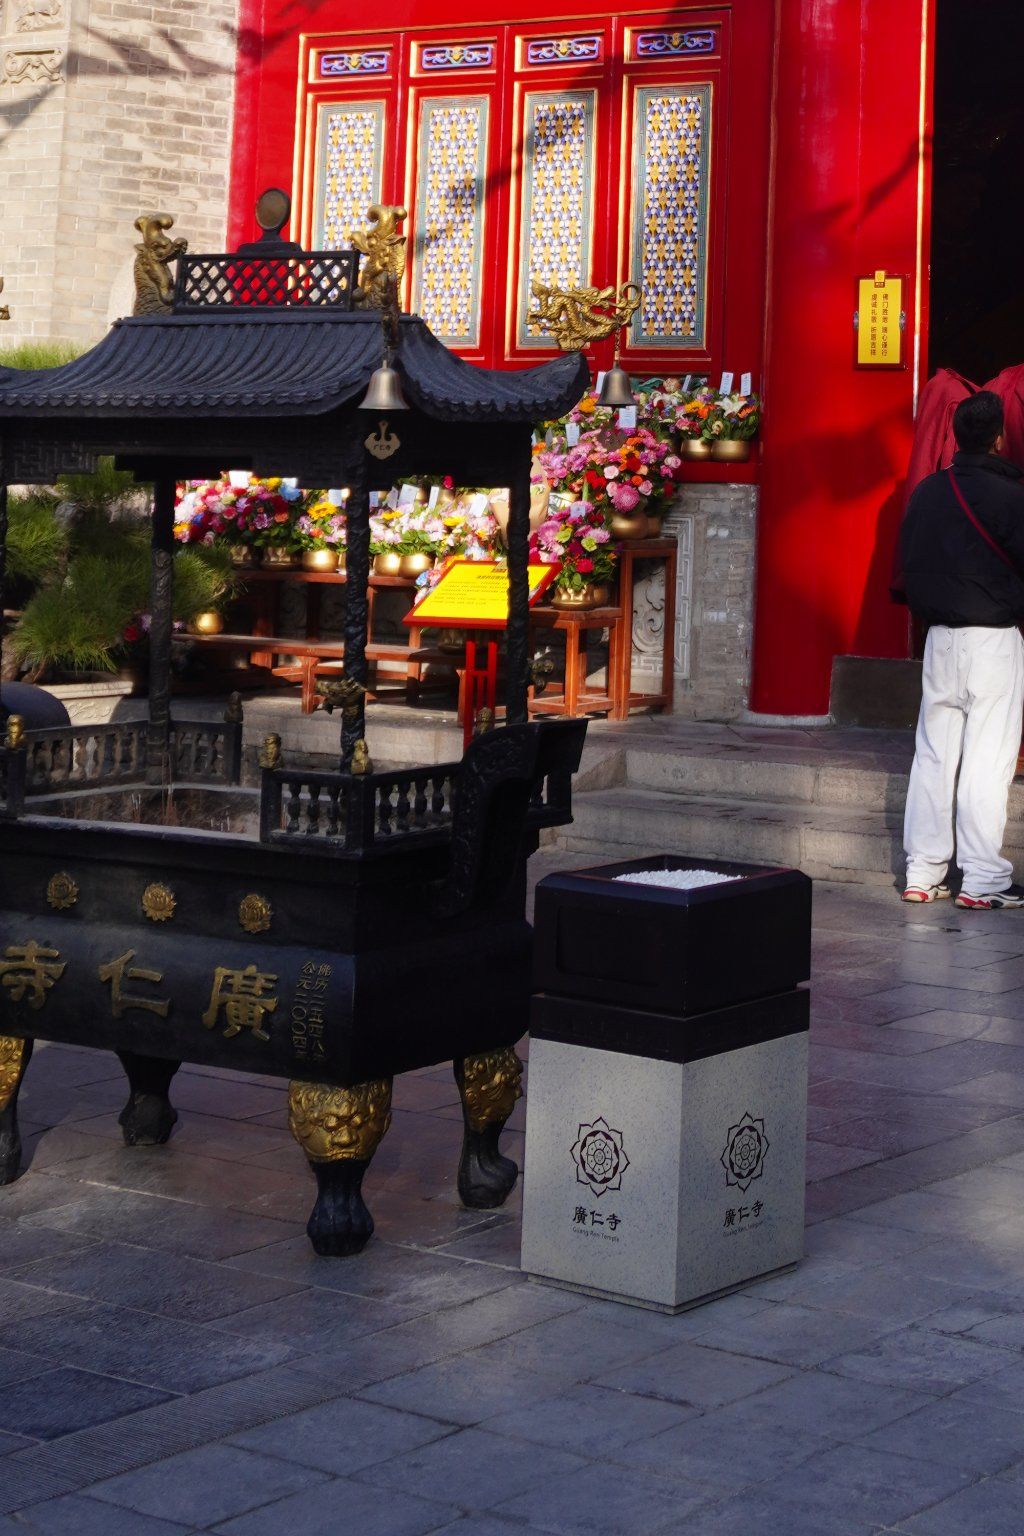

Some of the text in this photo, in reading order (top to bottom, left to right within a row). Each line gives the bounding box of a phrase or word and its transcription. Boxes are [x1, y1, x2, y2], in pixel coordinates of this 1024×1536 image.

[572, 1206, 622, 1231] 廣仁寺
[723, 1200, 763, 1228] 廣仁寺
